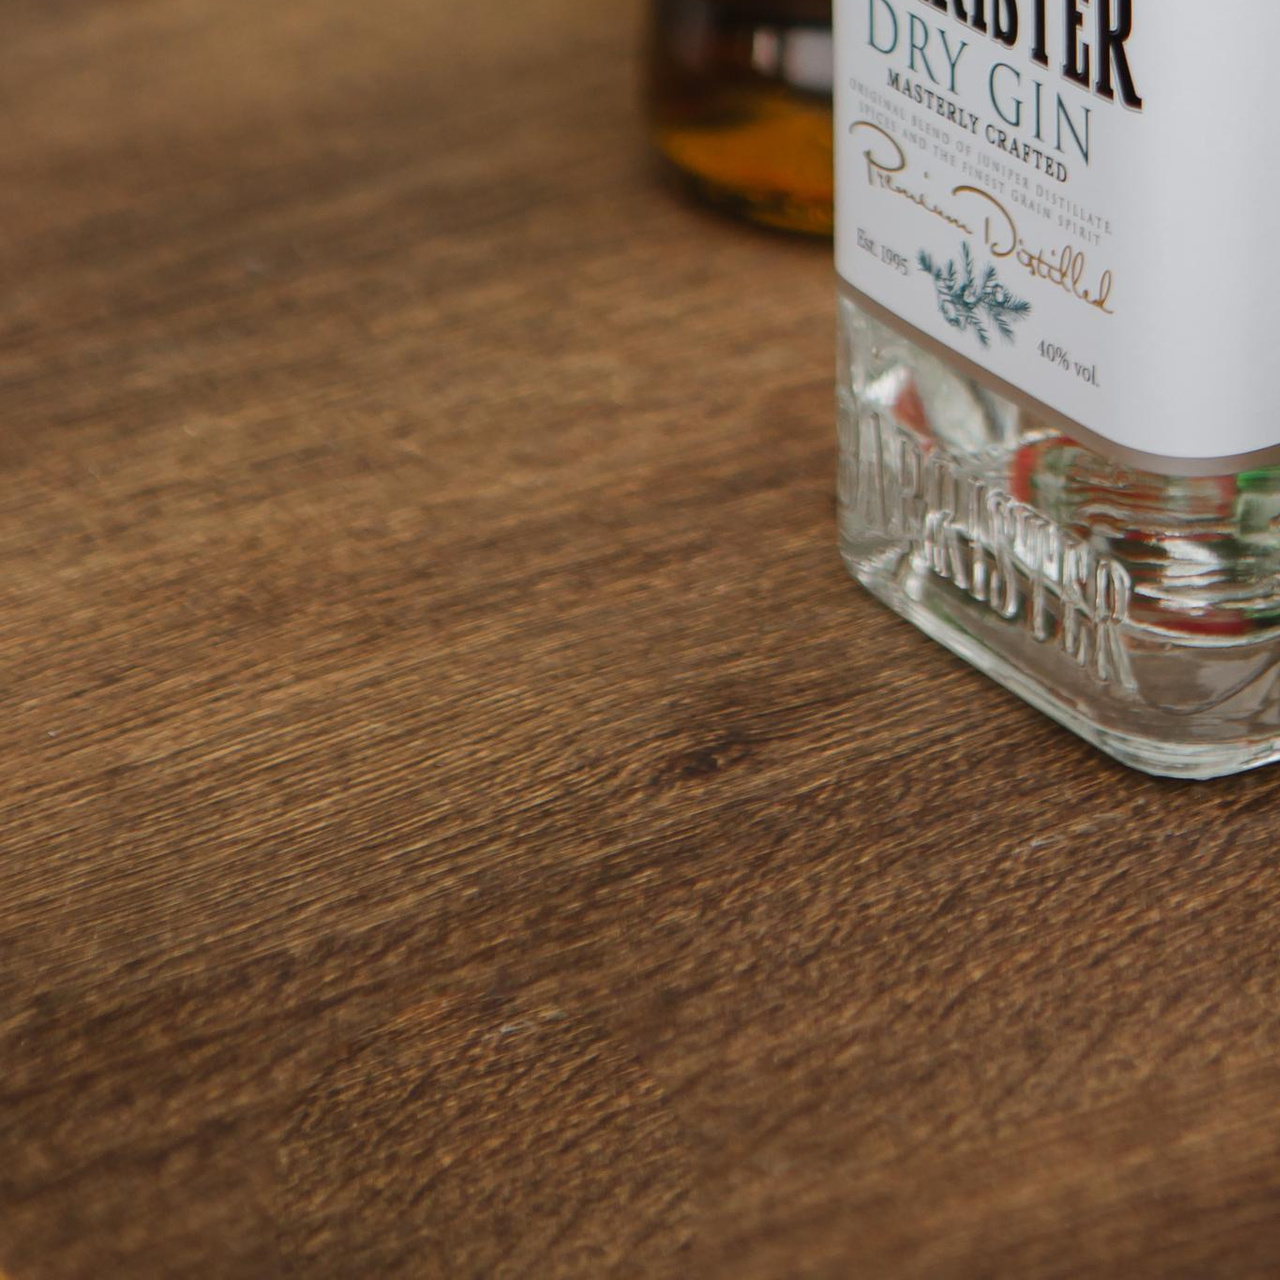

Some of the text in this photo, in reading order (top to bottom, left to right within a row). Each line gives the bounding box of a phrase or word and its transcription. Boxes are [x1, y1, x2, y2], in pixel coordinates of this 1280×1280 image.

[850, 77, 906, 122] ORIGINAL
[910, 114, 951, 146] BLEND
[956, 138, 973, 155] OF
[976, 151, 1030, 188] JUNIPER
[886, 68, 1068, 183] MASTERLY CRAFTED
[989, 62, 1092, 166] GIN
[848, 120, 1115, 315] Premium Distilled
[858, 100, 1102, 246] SPICES AND THE FINEST GRAIN SPIRIT
[880, 244, 910, 277] 1995
[1036, 339, 1101, 388] 40% vol.
